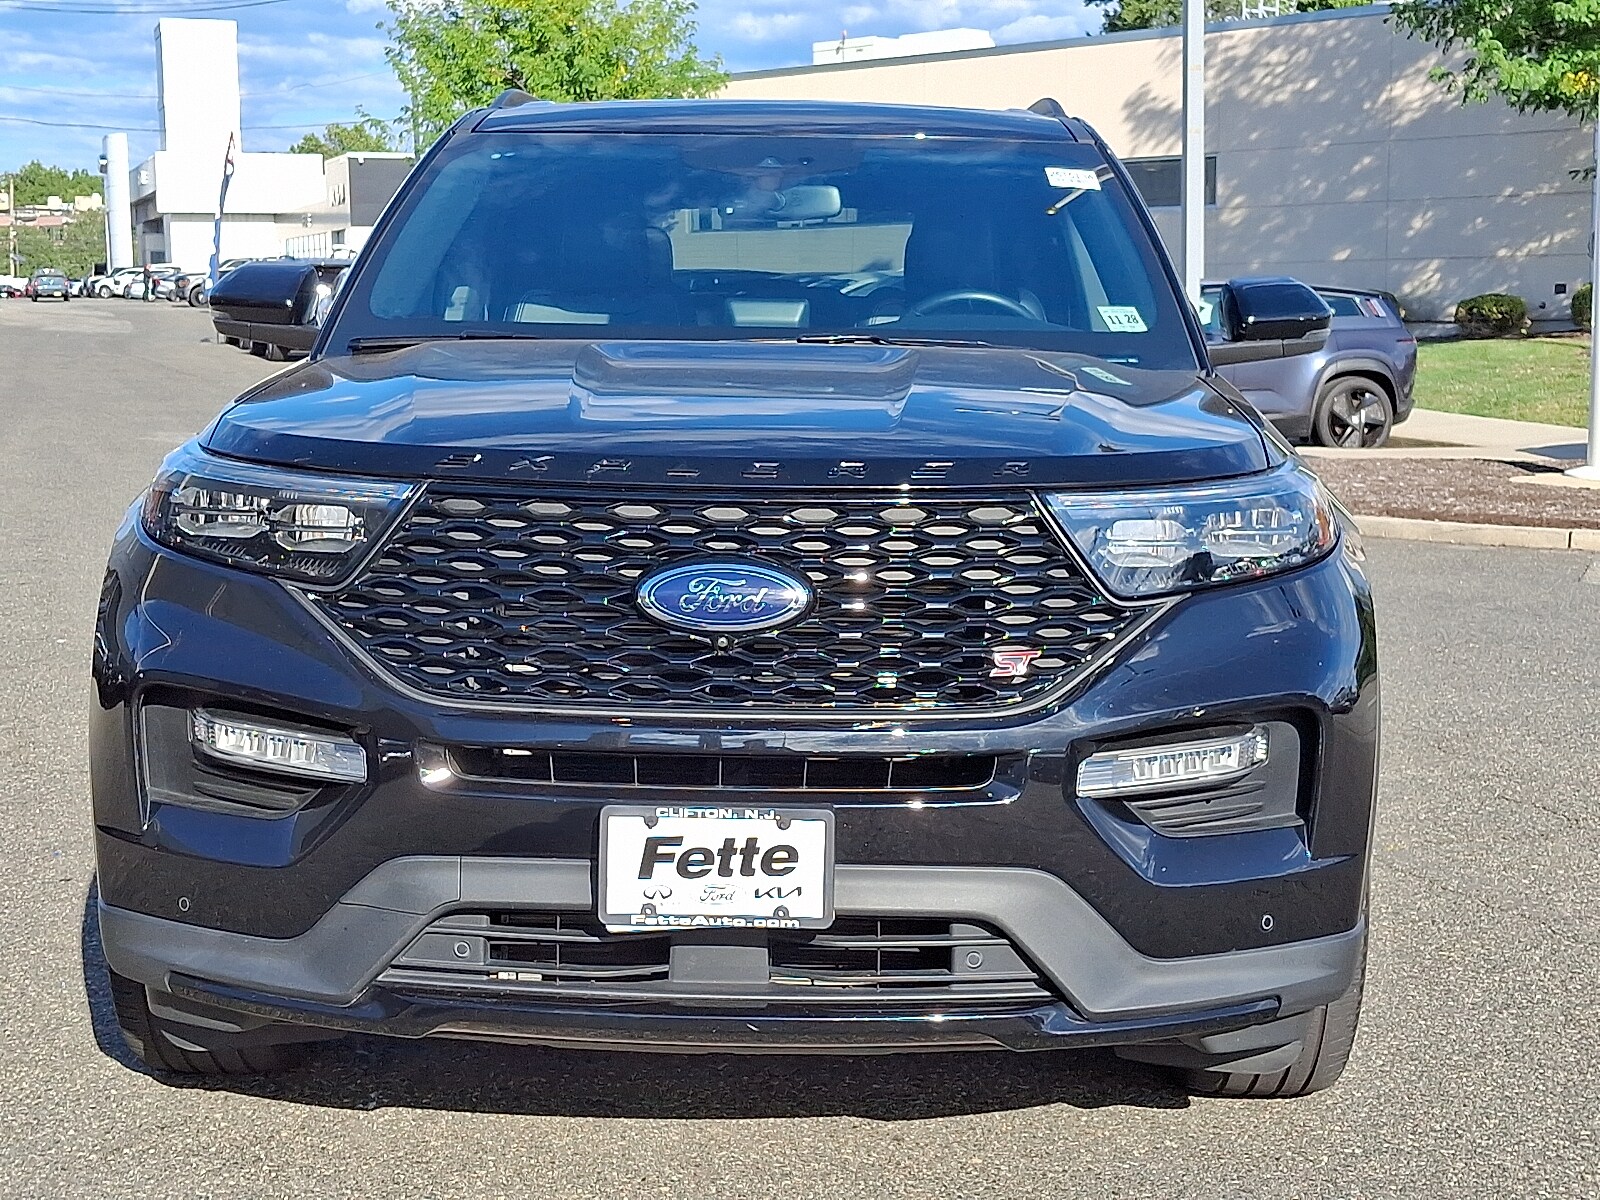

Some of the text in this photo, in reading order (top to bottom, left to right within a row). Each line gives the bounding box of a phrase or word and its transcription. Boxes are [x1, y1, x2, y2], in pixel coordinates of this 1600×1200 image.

[1108, 315, 1123, 324] 11
[434, 452, 1032, 478] EXPLORER
[679, 576, 769, 614] Ford
[989, 650, 1042, 677] ST
[744, 809, 781, 820] N.J.
[637, 836, 800, 880] Fette
[699, 886, 736, 902] Ford
[630, 914, 801, 929] FetteAuto.com
